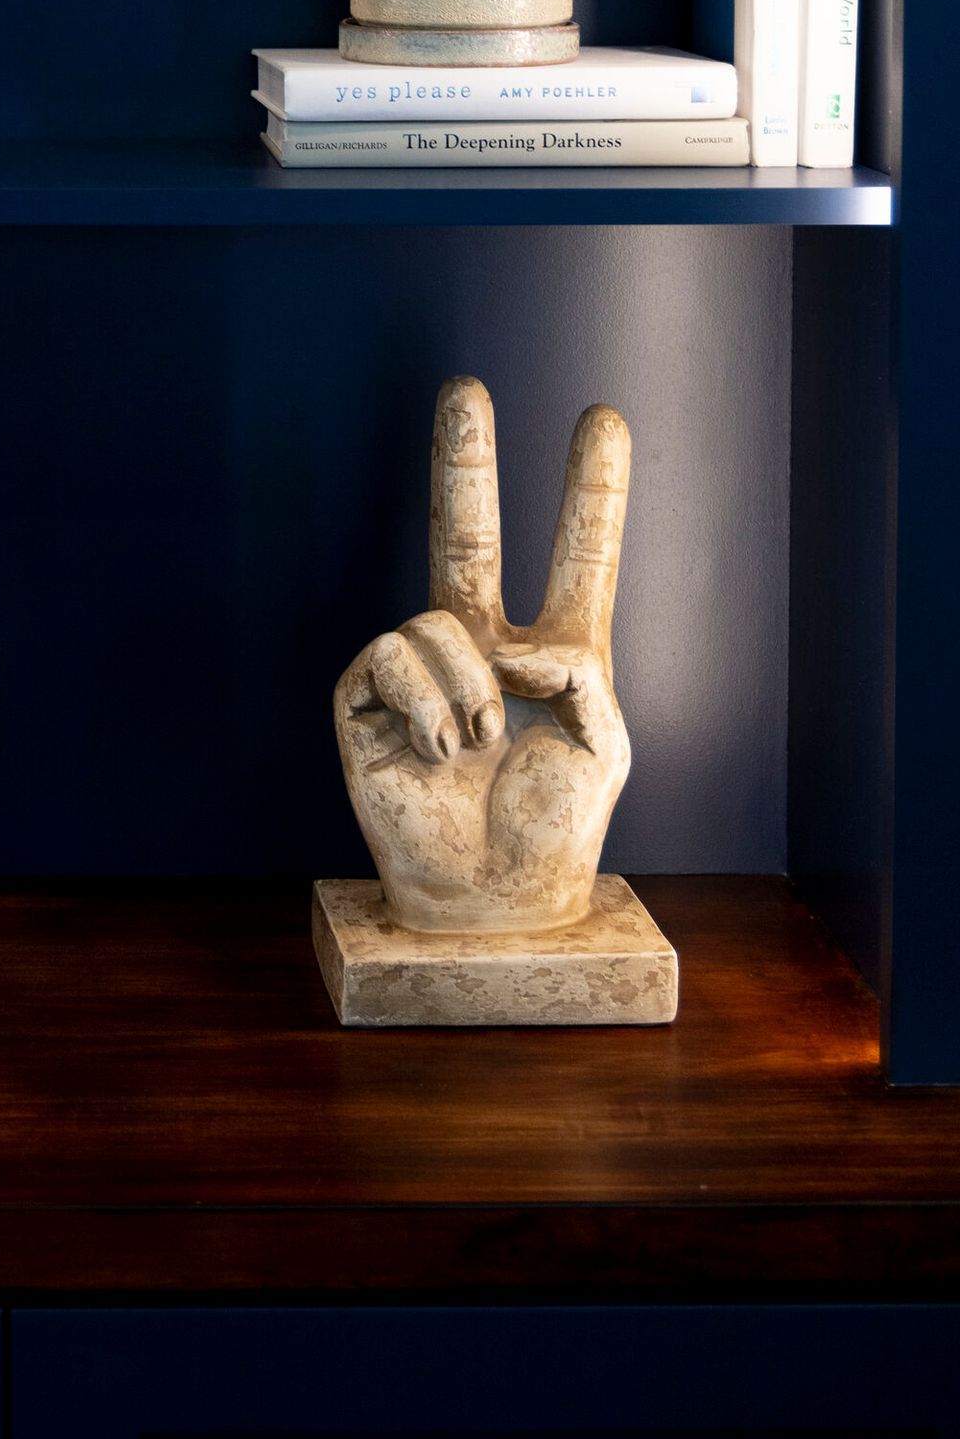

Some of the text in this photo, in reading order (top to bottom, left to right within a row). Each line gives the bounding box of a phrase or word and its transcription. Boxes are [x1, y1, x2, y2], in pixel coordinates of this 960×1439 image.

[336, 81, 617, 103] yes please AMY POEHLER
[402, 133, 438, 149] The
[444, 133, 536, 152] Deepening
[542, 132, 622, 148] Darkness
